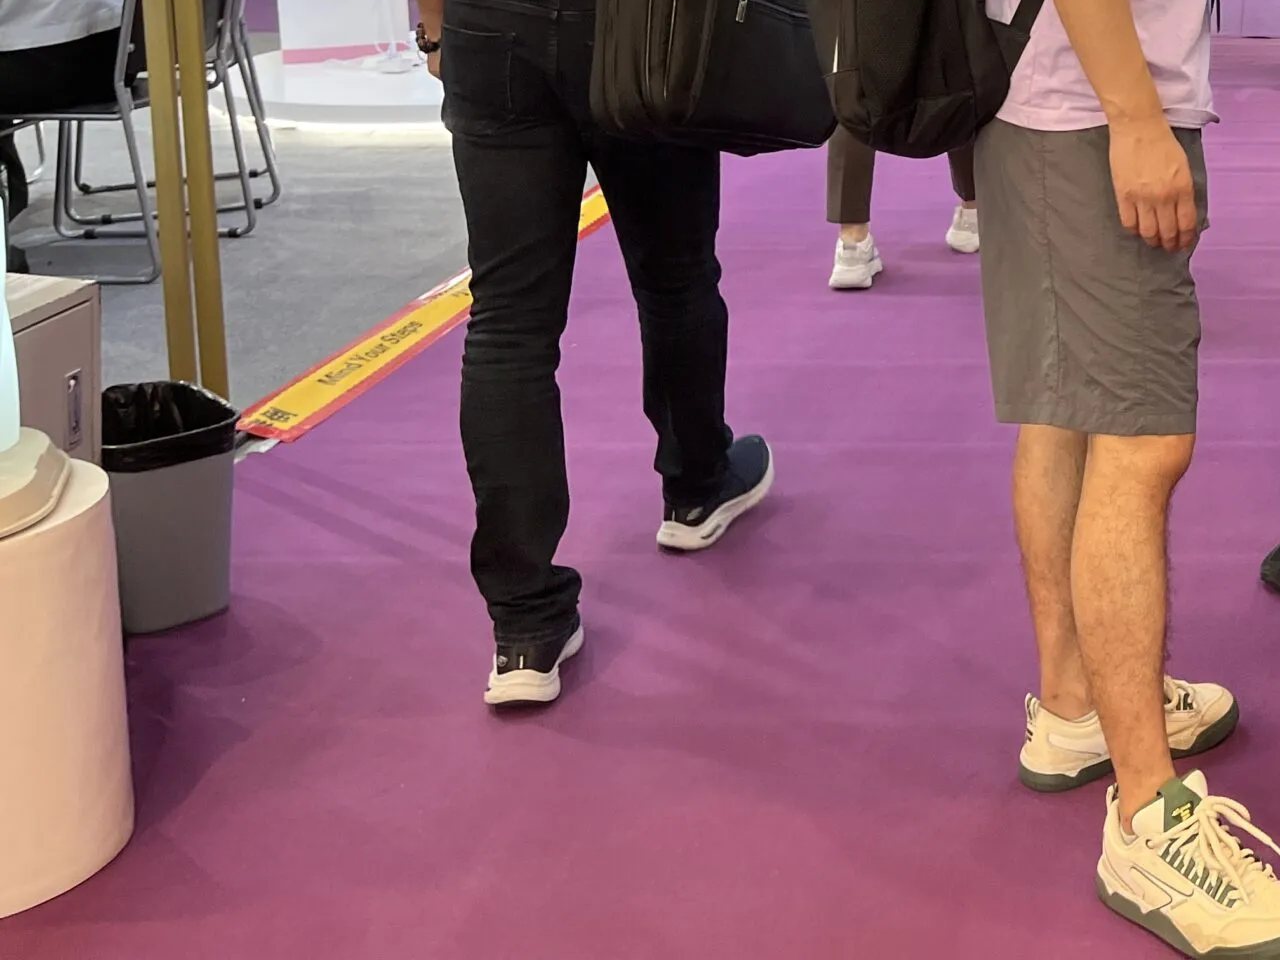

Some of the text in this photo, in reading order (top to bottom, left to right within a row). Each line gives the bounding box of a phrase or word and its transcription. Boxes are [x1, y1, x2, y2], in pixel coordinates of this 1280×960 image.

[317, 321, 423, 385] Mind Your Steps
